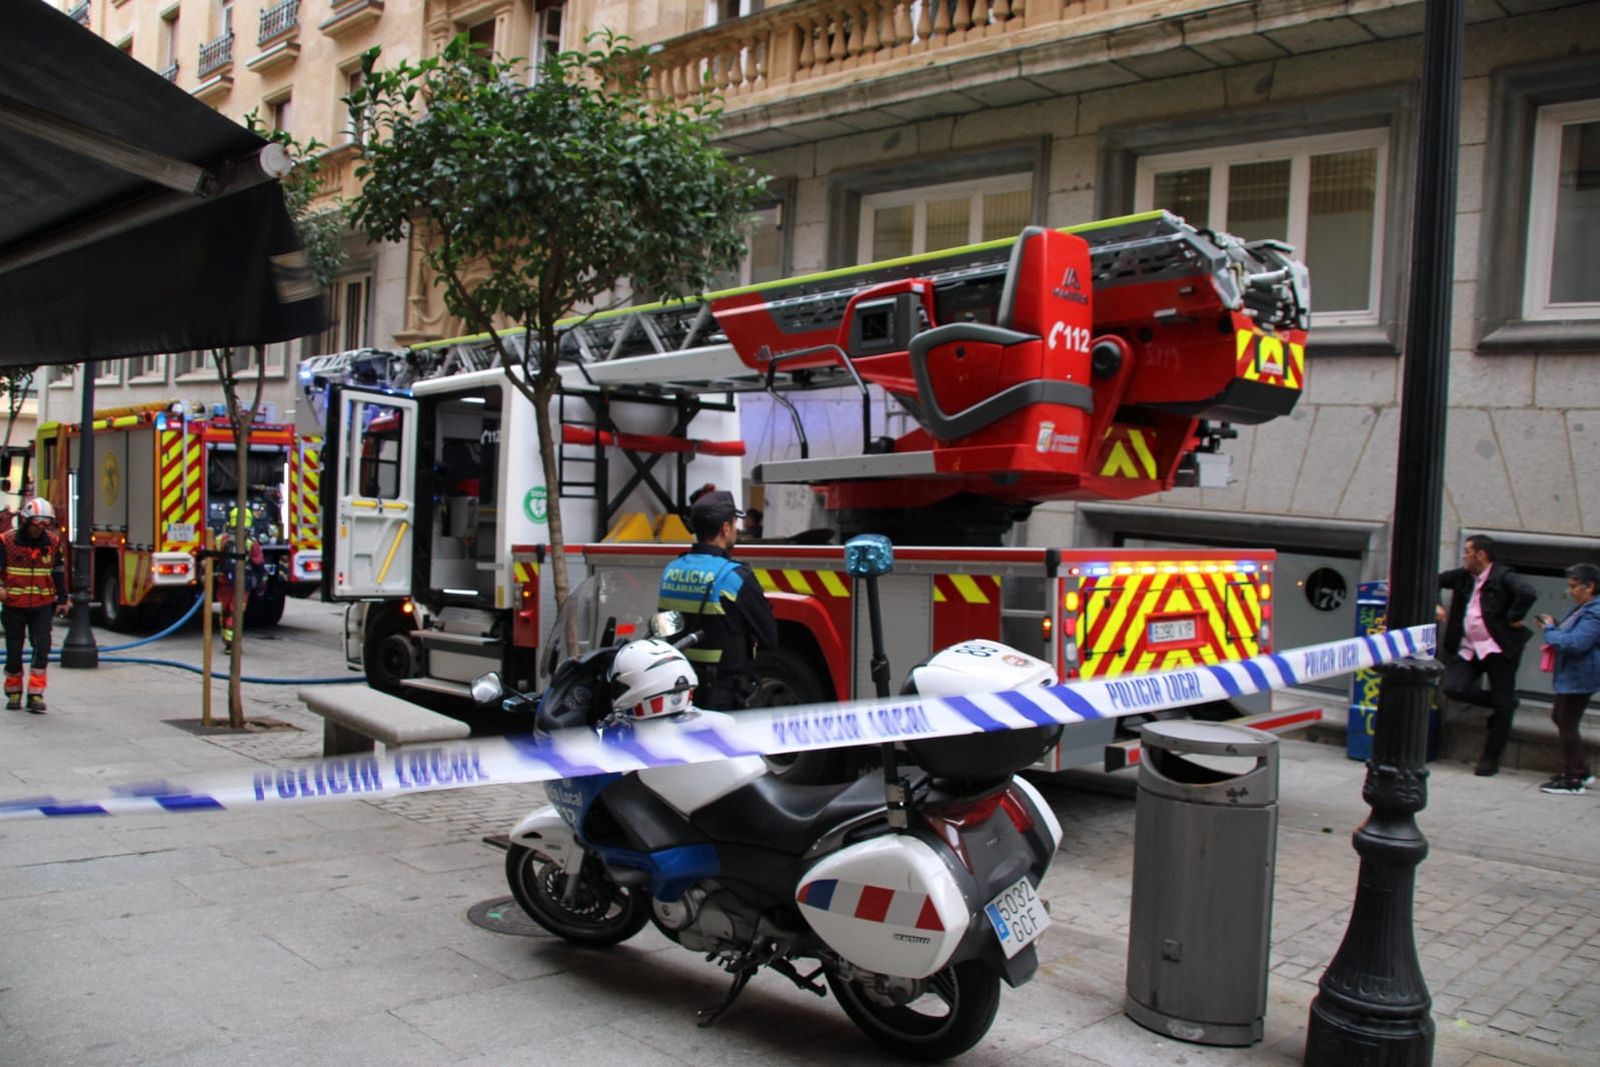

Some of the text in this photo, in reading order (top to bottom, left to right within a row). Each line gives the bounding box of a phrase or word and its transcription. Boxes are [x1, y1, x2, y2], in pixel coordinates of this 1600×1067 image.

[1063, 325, 1090, 353] 112
[662, 582, 713, 594] SALAMANC
[663, 568, 715, 583] POLICIA
[1304, 643, 1360, 677] POLICIA LOCAL
[1105, 671, 1203, 709] POLICIA LOCAL
[772, 704, 938, 745] POLICIA LOCAL
[253, 756, 383, 801] POLICIA
[996, 880, 1035, 921] 5032
[1012, 907, 1037, 943] GCF
